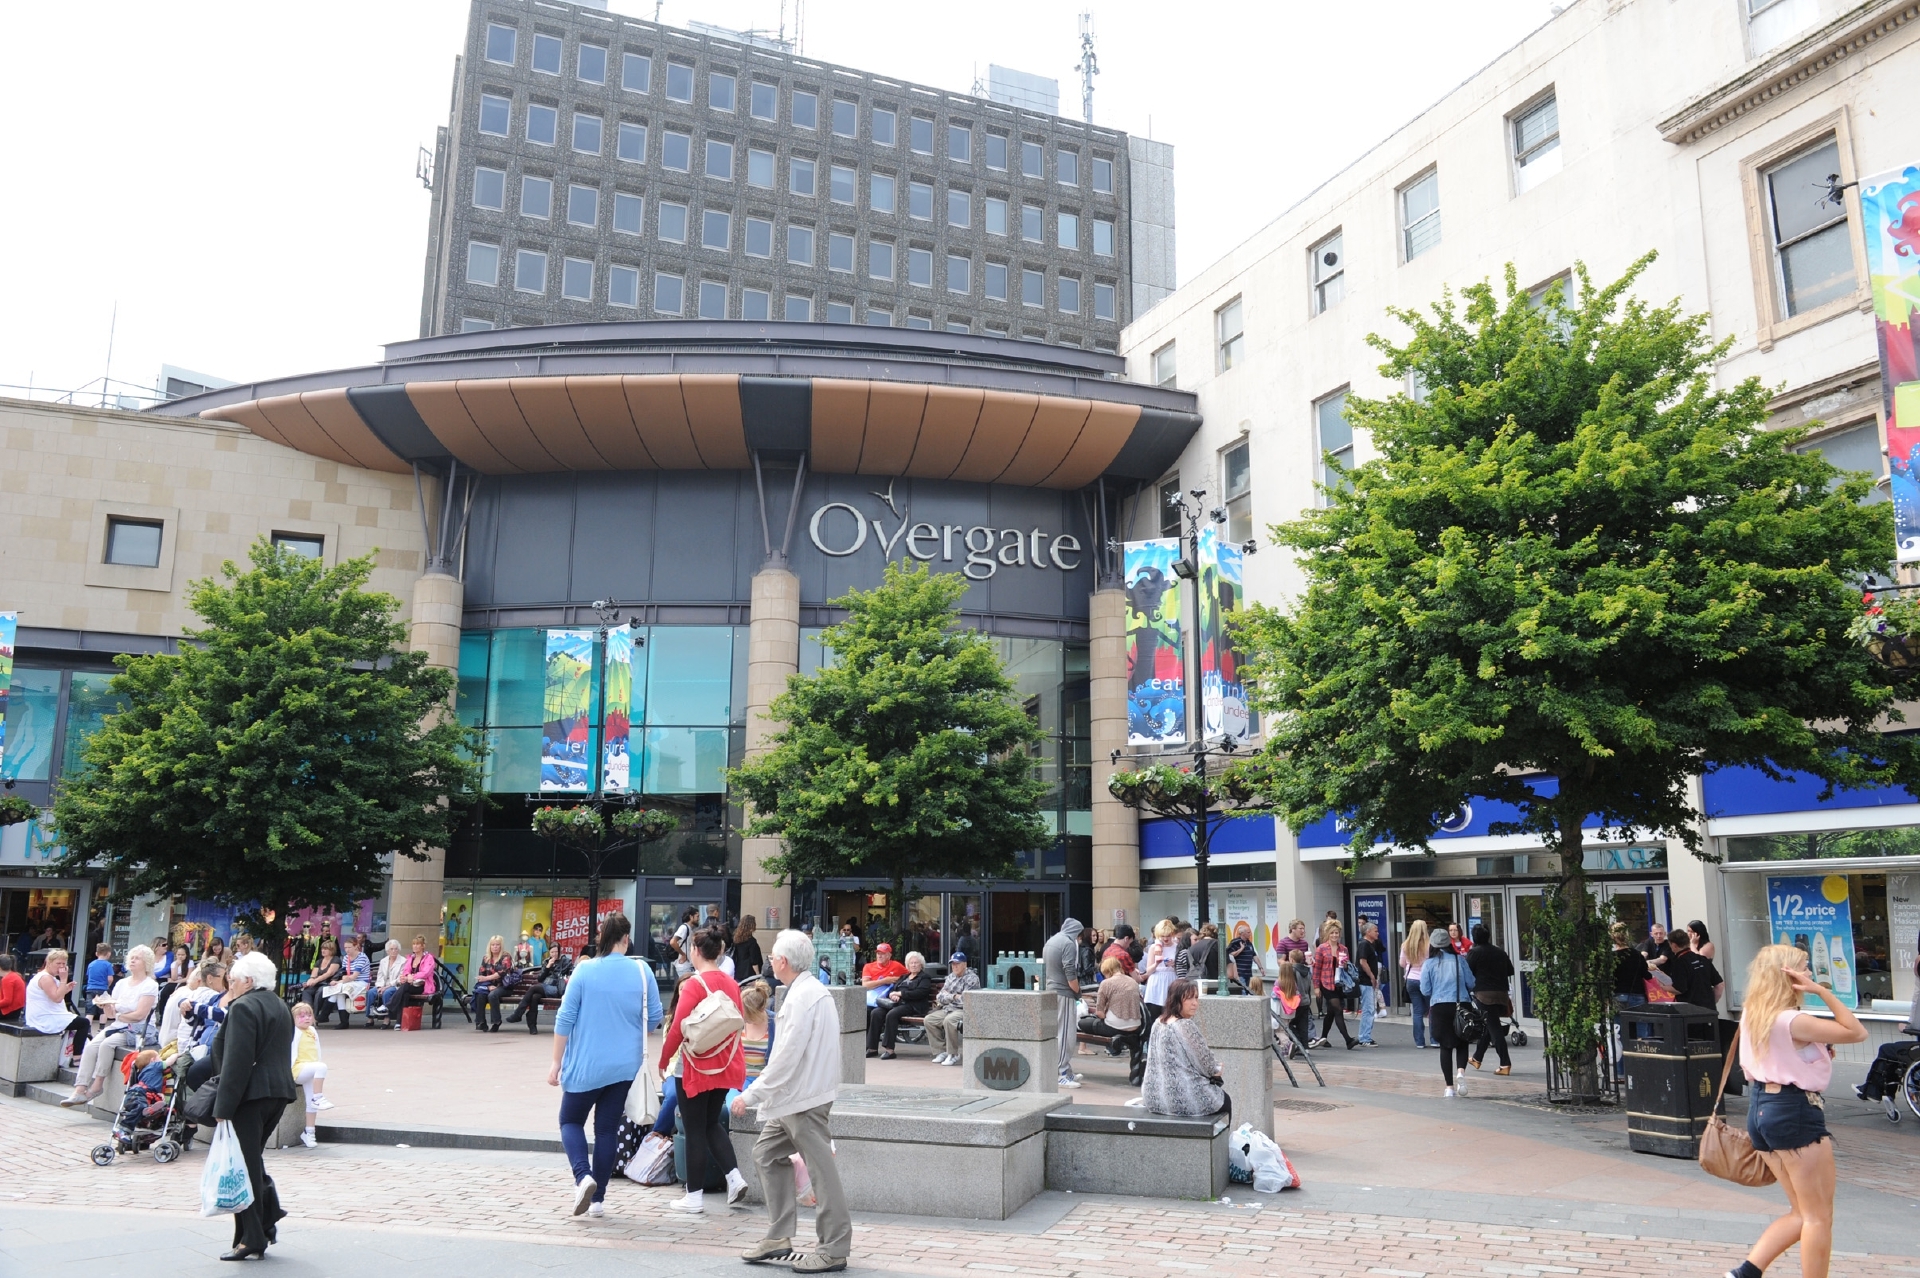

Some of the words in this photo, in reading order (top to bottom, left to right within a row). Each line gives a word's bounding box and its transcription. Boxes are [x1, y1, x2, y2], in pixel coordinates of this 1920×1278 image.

[809, 502, 1081, 580] Overgate
[1151, 677, 1182, 691] eat
[1223, 705, 1249, 719] undee
[1358, 899, 1383, 907] welcome
[1773, 895, 1804, 915] 1/2
[1805, 904, 1835, 918] price
[984, 1057, 1019, 1081] MM
